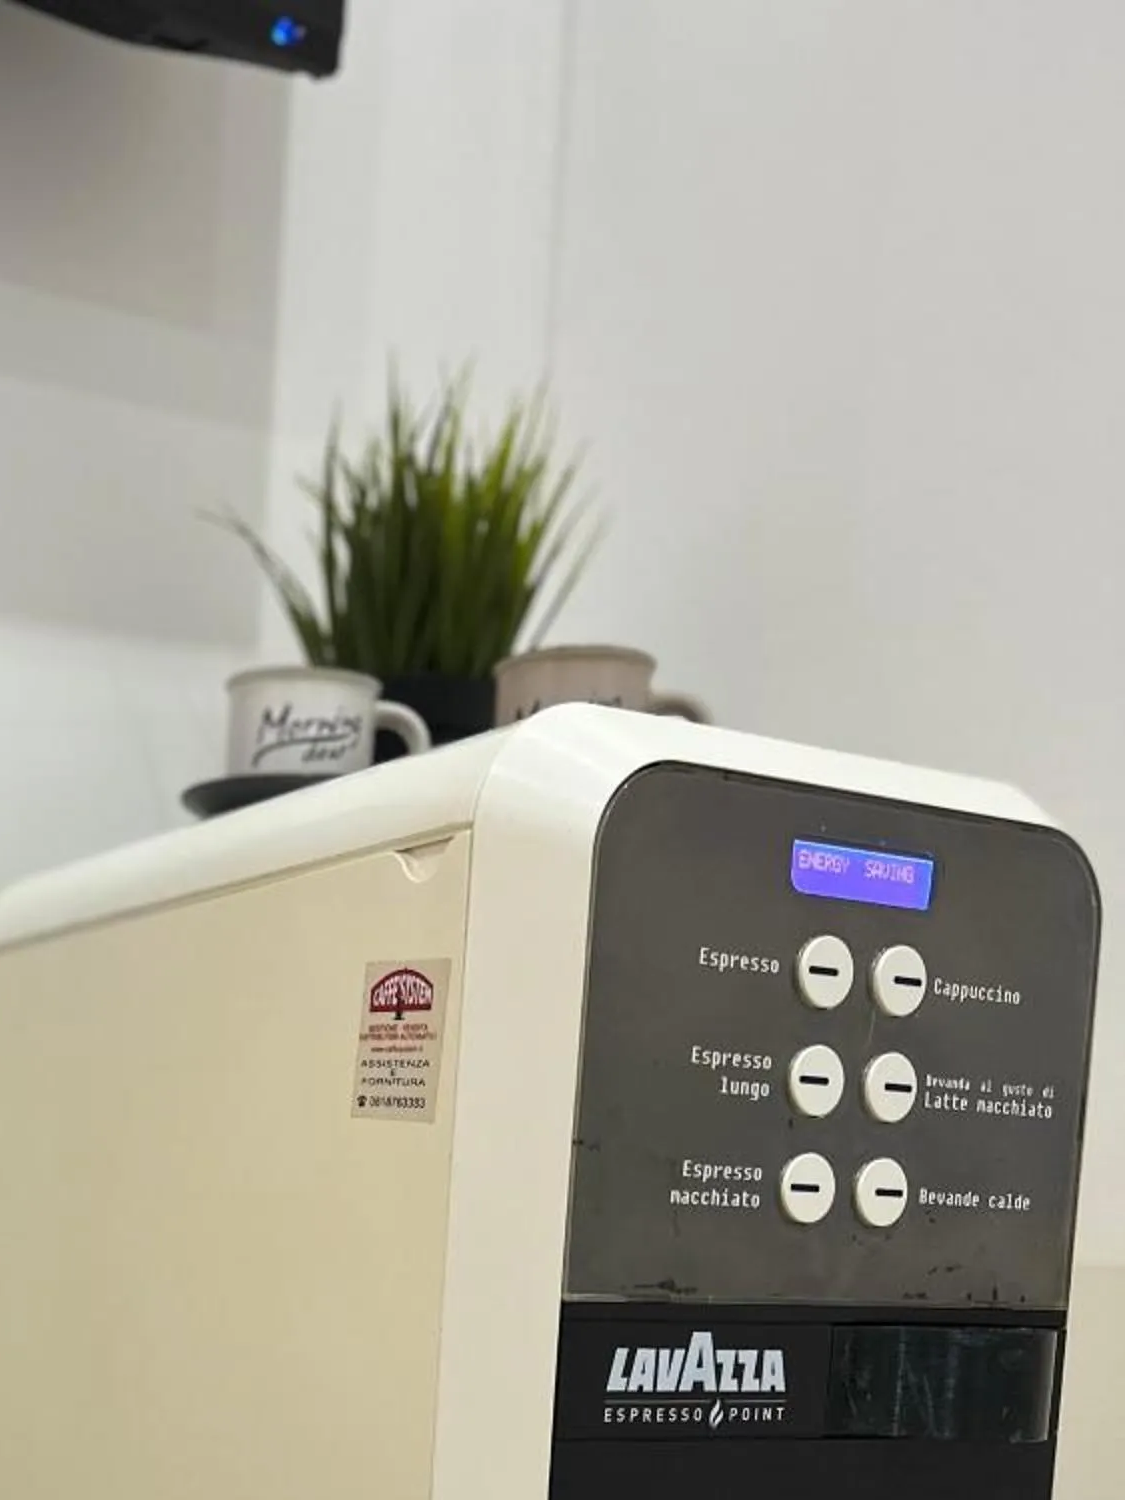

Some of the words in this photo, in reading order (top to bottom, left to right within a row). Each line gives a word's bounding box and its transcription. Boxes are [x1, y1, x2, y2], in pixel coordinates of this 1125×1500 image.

[798, 850, 850, 873] ENERGY
[864, 860, 915, 884] SAVING
[699, 947, 780, 973] Espresso
[934, 978, 1020, 1005] Cappuccino
[361, 1059, 430, 1069] ASSISTENZA
[691, 1045, 772, 1070] Espresso
[720, 1076, 770, 1101] lungo
[924, 1090, 969, 1111] Latte
[976, 1098, 1053, 1119] macchiato
[682, 1159, 763, 1183] Espresso
[669, 1187, 761, 1209] macchiato
[918, 1186, 980, 1208] Bevande
[988, 1193, 1031, 1211] calde
[606, 1331, 786, 1393] LAVAZZA
[603, 1407, 703, 1423] ESPRESSO
[728, 1407, 786, 1422] POINT
